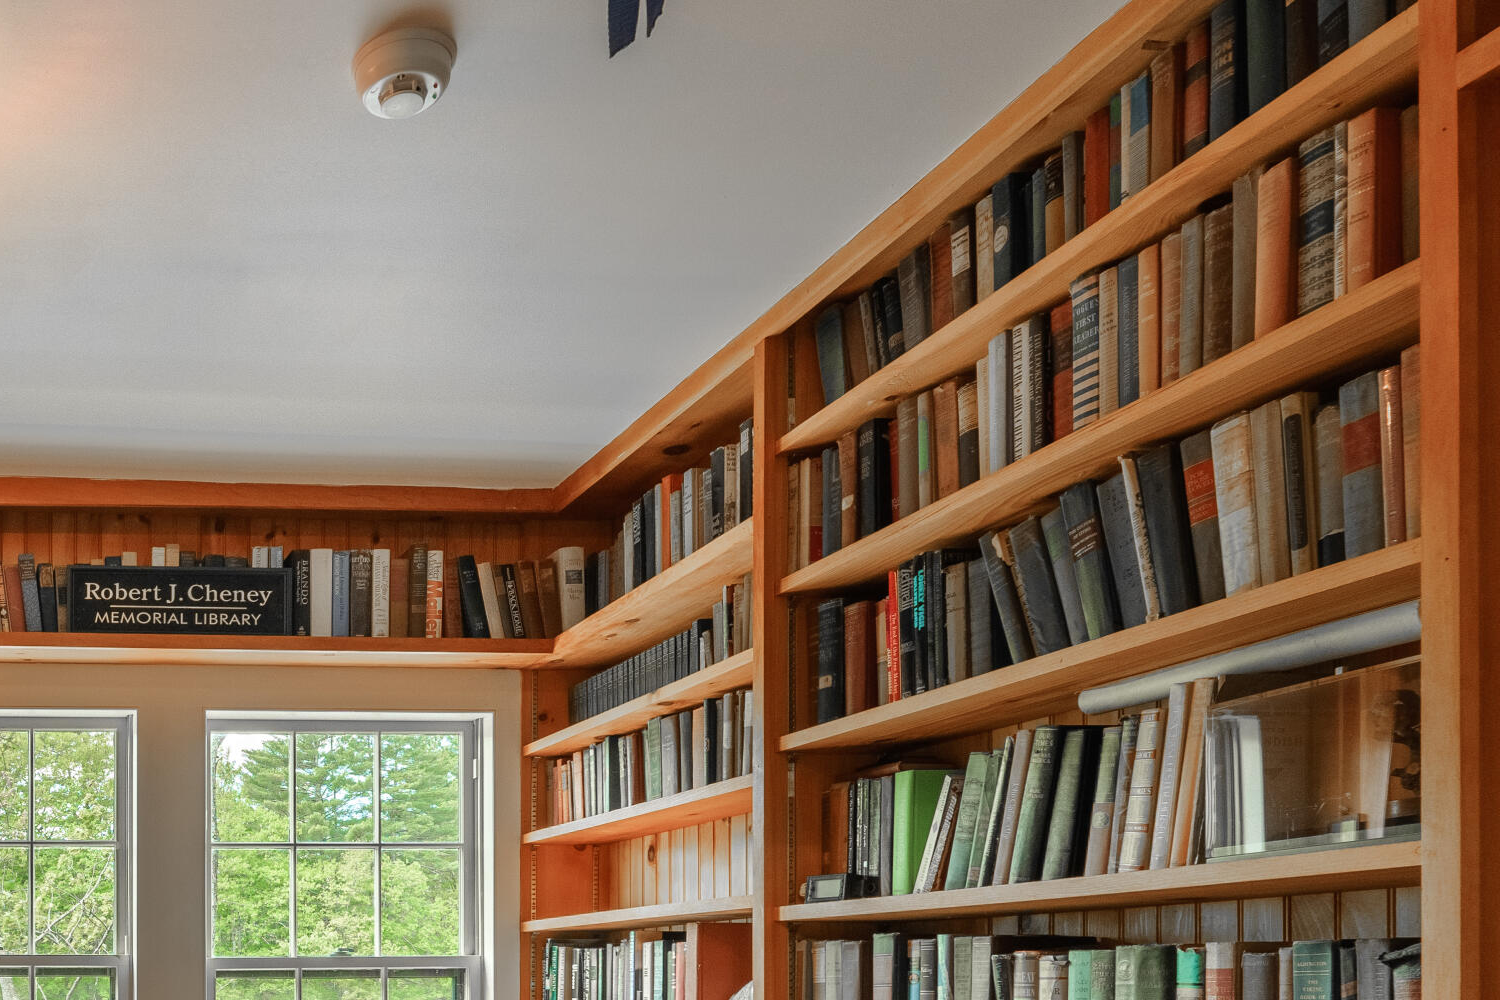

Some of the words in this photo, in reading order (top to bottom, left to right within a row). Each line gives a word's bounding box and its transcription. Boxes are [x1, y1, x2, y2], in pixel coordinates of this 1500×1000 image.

[1013, 327, 1023, 362] BULLET
[1013, 365, 1023, 389] PARK
[1034, 353, 1043, 393] LOOKING
[1013, 395, 1023, 418] JOHN
[1034, 395, 1043, 423] GLASS
[1034, 424, 1042, 447] WAR
[84, 582, 162, 601] Robert
[166, 583, 185, 603] J.
[187, 584, 273, 606] Cheney
[301, 560, 309, 605] BRANDO
[917, 569, 925, 604] LONELY
[426, 580, 442, 638] Mailer
[508, 590, 517, 611] BACK
[94, 611, 188, 625] MEMORIAL
[194, 613, 261, 626] LIBRARY
[512, 610, 522, 635] HOME
[917, 606, 925, 631] VIGIL
